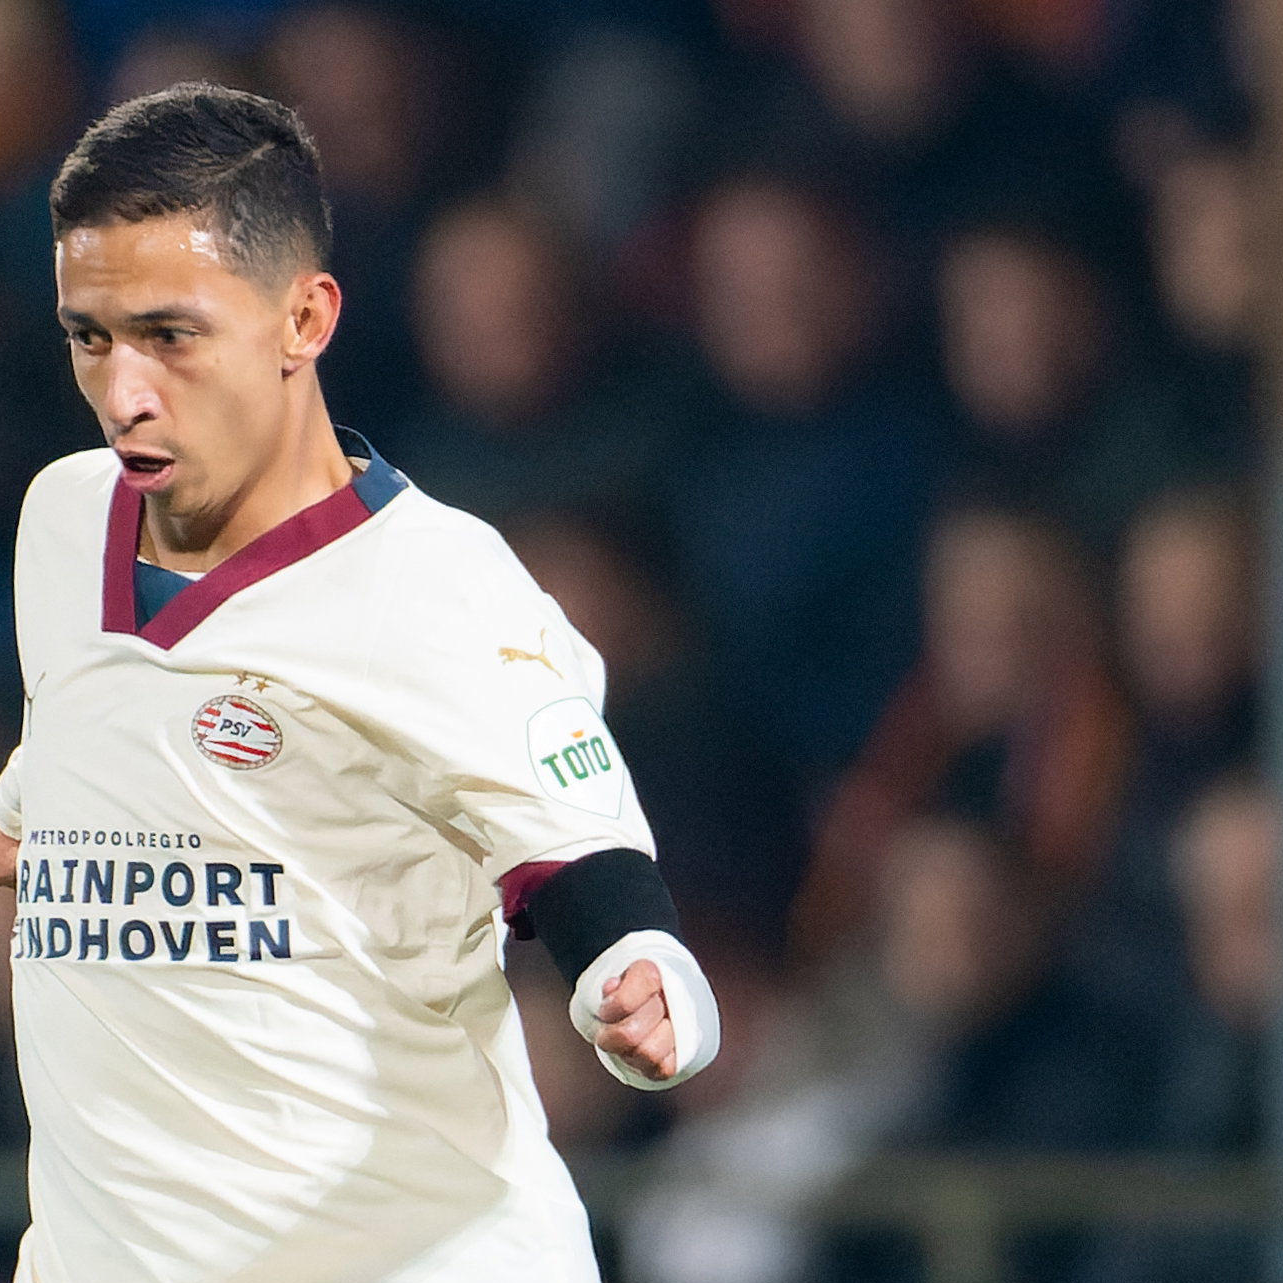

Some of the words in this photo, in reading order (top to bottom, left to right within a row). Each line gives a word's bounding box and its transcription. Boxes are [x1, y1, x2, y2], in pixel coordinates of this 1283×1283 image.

[219, 718, 252, 738] PSV
[540, 736, 612, 788] TOTO
[28, 829, 202, 849] METROPOOLREGIO
